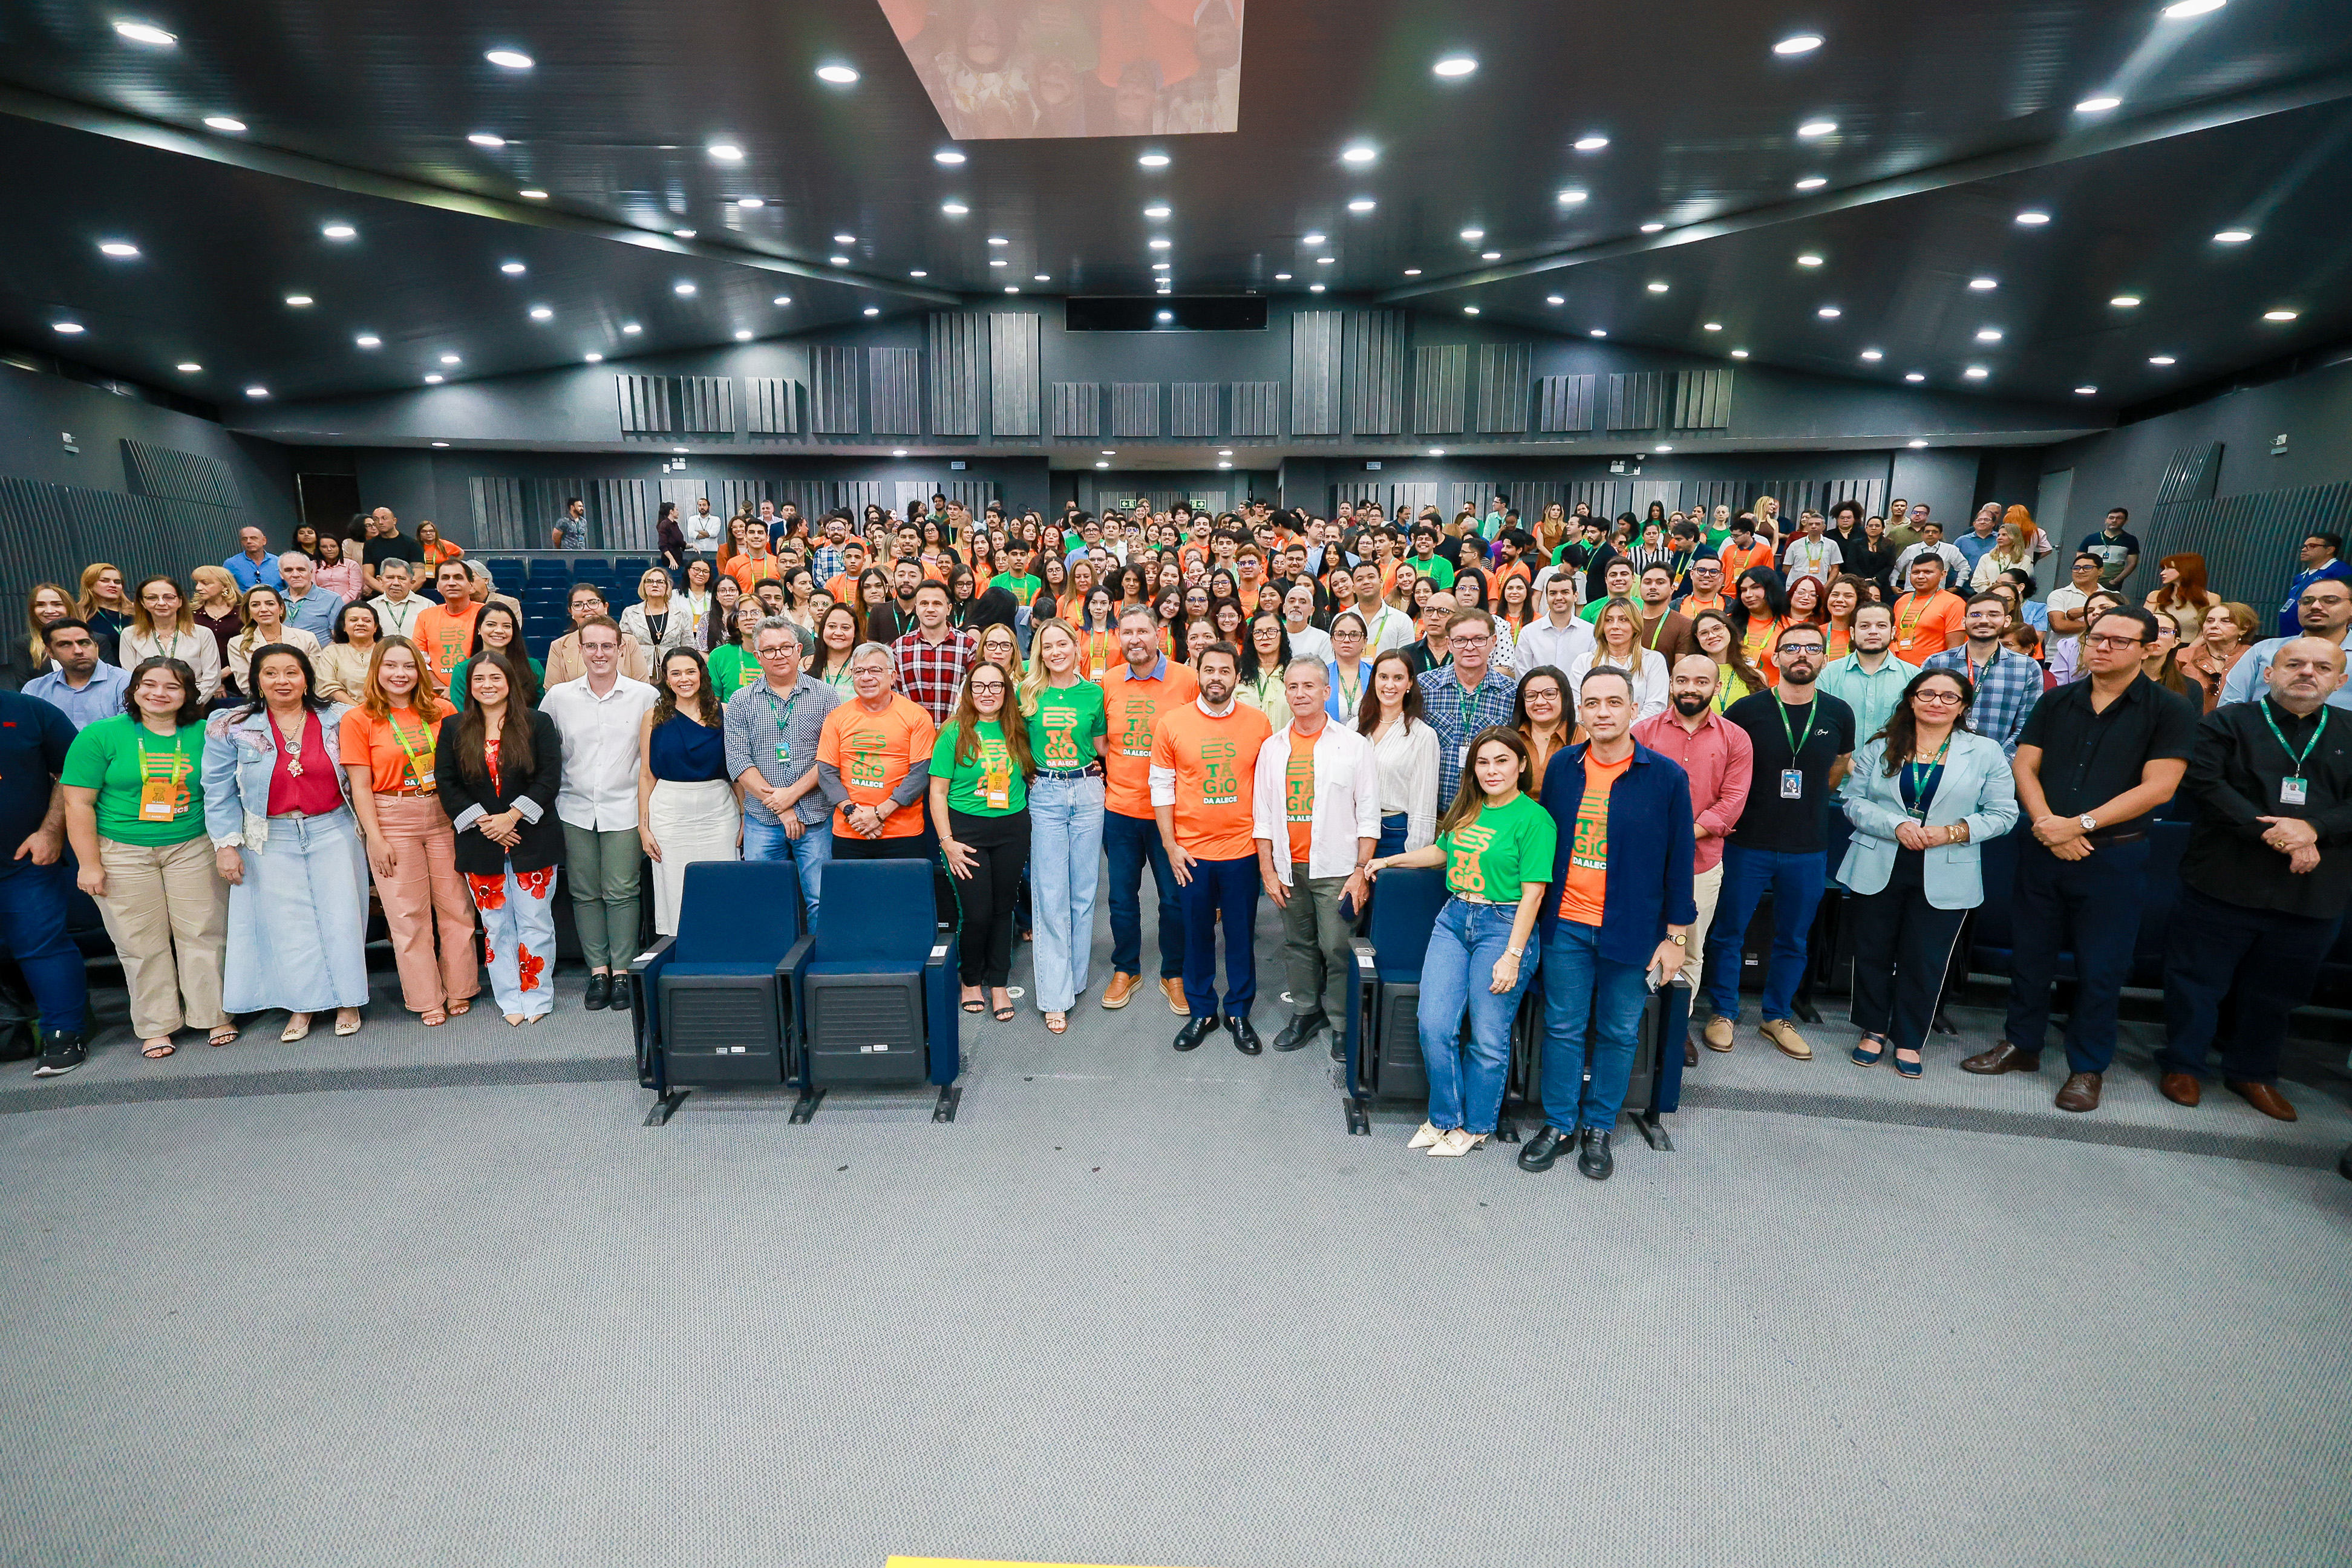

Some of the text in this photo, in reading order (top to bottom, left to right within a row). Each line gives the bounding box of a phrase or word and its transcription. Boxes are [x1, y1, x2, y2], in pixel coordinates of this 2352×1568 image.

[440, 630, 466, 641] ES
[443, 641, 464, 654] TÁ
[1126, 700, 1155, 714] ES
[1043, 712, 1077, 727] ES
[1127, 716, 1151, 732] TÁ
[852, 734, 886, 748] ES
[1047, 727, 1074, 744] TÁ
[856, 750, 881, 763] TÁ
[1201, 742, 1236, 759] ES
[1206, 759, 1234, 777] TÁ
[860, 779, 884, 788] ALECE
[1454, 850, 1481, 874] TÁ
[1573, 857, 1607, 870] DA ALEC
